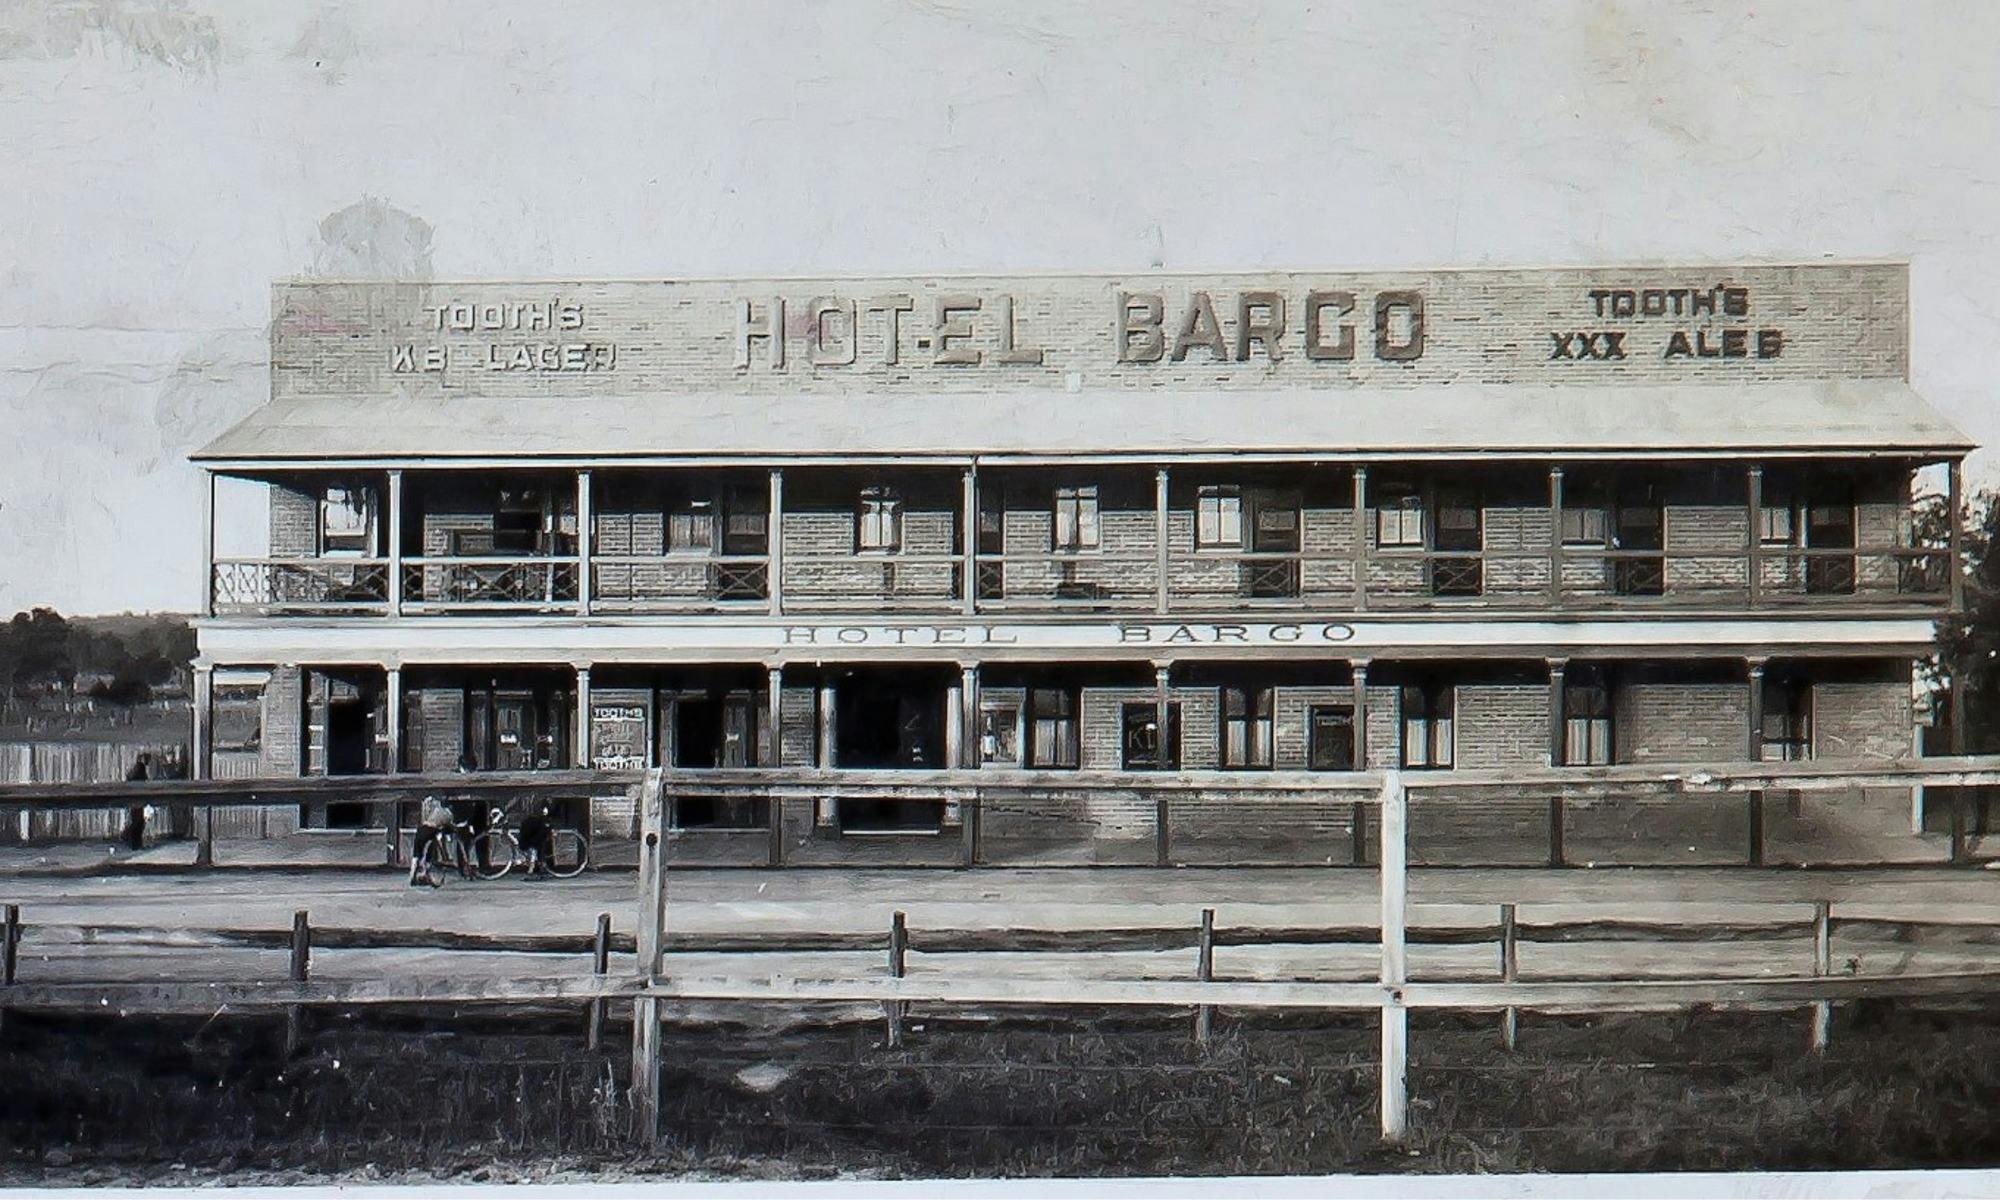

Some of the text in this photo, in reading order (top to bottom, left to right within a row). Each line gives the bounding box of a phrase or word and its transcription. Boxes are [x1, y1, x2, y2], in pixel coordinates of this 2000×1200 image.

[736, 290, 1425, 368] HOTEL BARGO
[1550, 331, 1628, 360] XXX
[784, 624, 1356, 643] HOTEL BARGO
